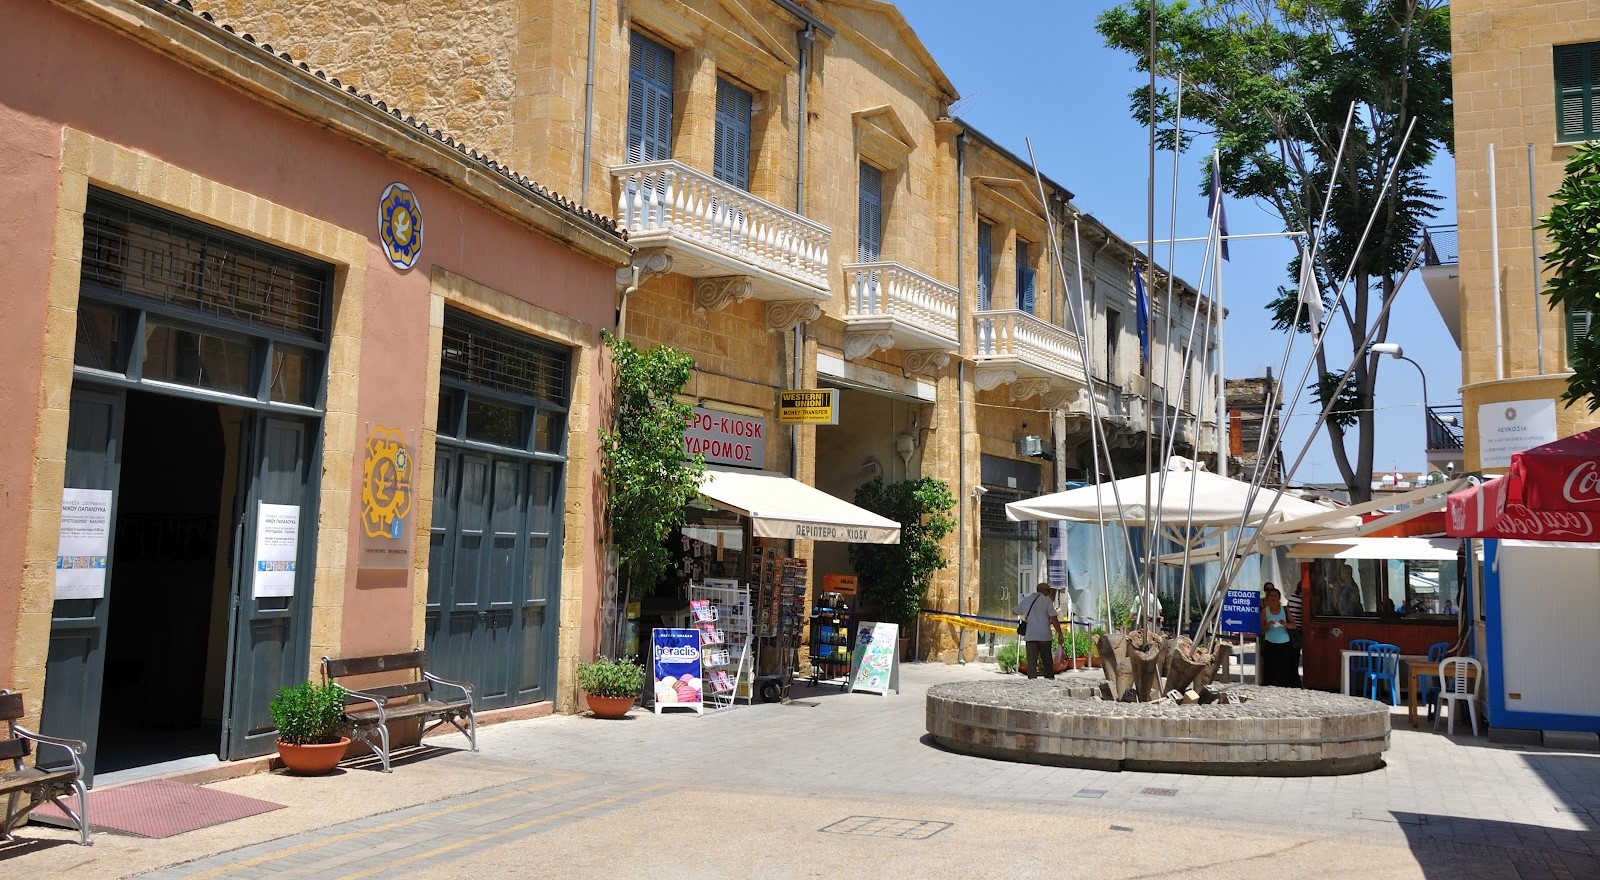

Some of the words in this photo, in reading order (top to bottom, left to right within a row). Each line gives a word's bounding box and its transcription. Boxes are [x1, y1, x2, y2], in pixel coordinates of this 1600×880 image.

[685, 412, 762, 439] ΕΡΟ-KIOSK
[685, 436, 752, 462] ΥΔΡΟΜΟΣ
[796, 524, 837, 538] ΠΕΡΙΠΤΕΡΟ
[847, 528, 868, 540] KIOSK
[1223, 605, 1260, 613] ENTRANCE
[656, 646, 696, 656] heraclis
